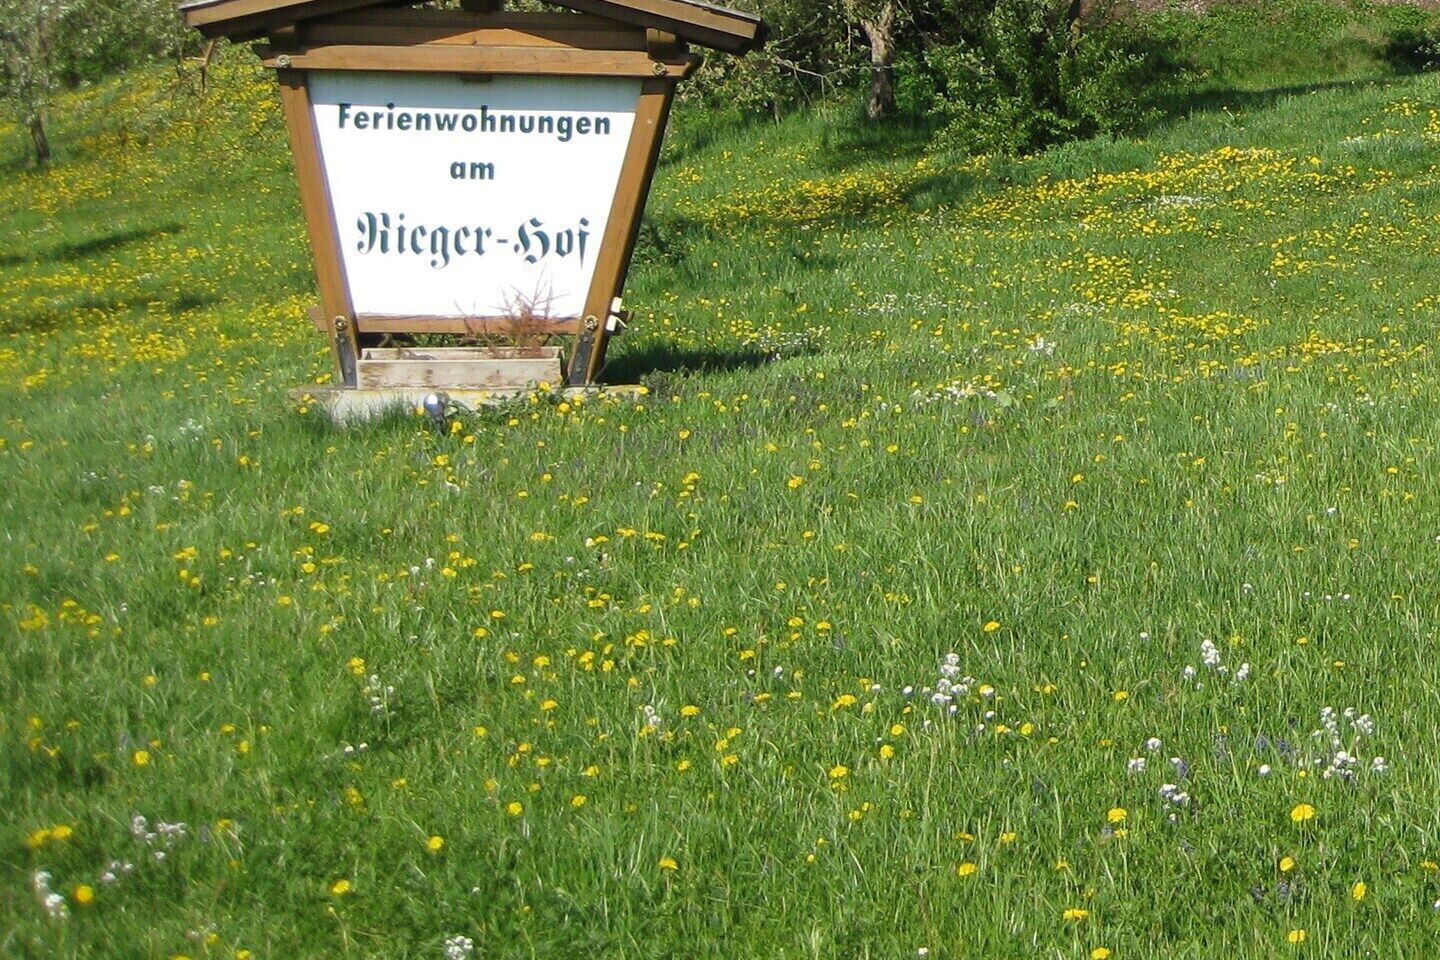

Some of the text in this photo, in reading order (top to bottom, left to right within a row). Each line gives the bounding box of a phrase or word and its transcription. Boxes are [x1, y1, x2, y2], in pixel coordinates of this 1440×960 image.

[338, 103, 611, 143] Ferienwohnungen
[449, 161, 495, 180] am
[356, 211, 590, 270] Rieger-Hof
